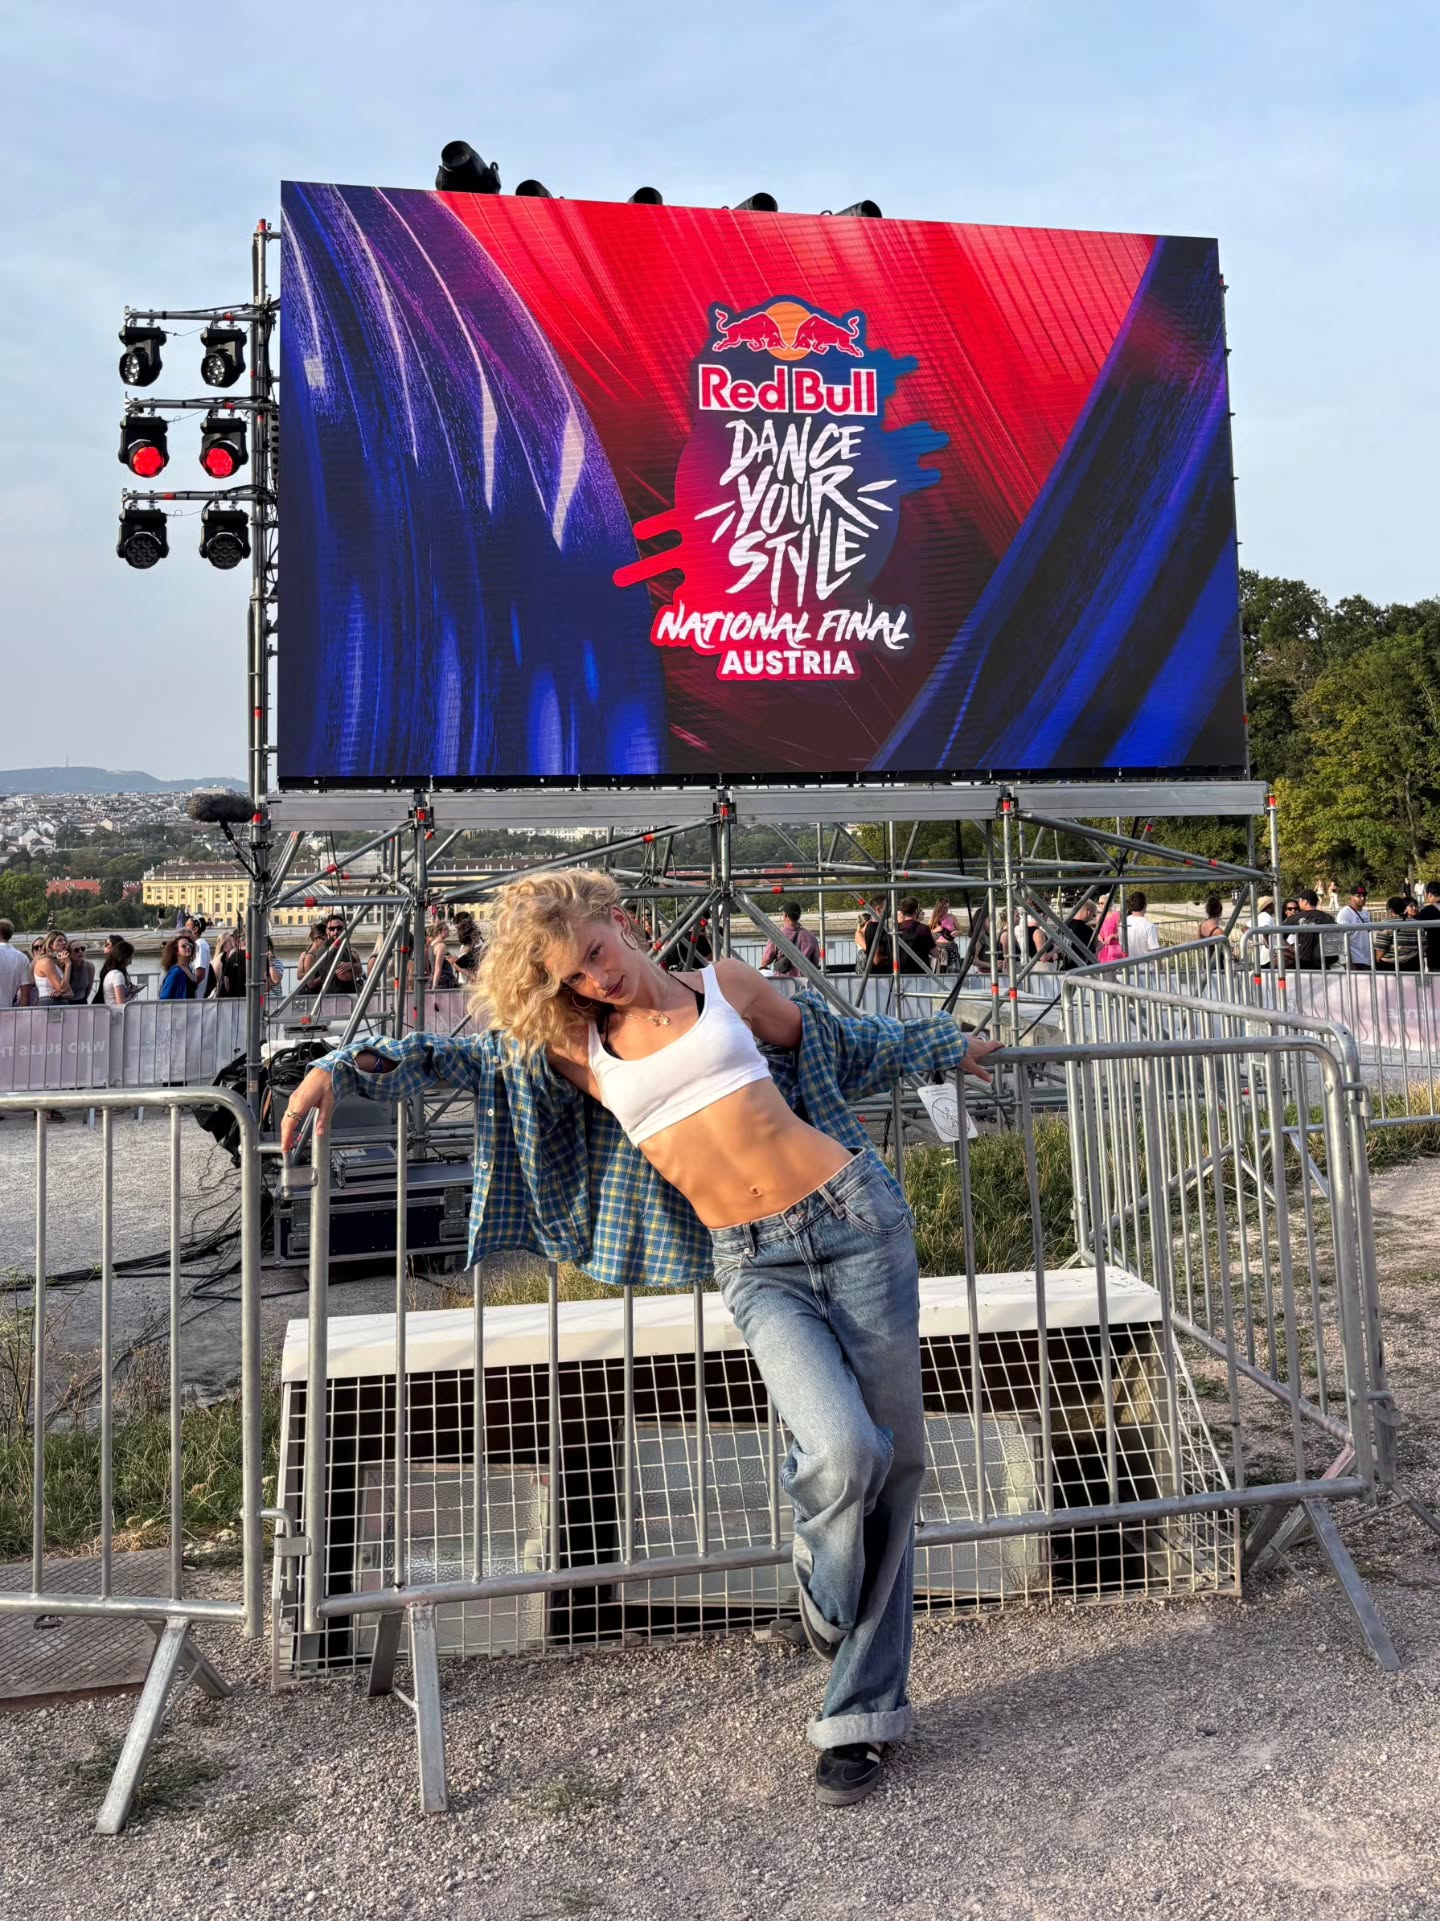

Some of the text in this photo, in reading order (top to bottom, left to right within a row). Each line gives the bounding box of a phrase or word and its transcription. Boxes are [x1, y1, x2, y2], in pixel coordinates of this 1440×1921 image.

[699, 364, 878, 416] Red Bull
[720, 417, 865, 486] DANCE
[735, 465, 879, 538] YOUR
[726, 510, 870, 607] STYLE
[657, 600, 910, 649] NATIONAL FINAL
[721, 651, 855, 675] AUSTRIA
